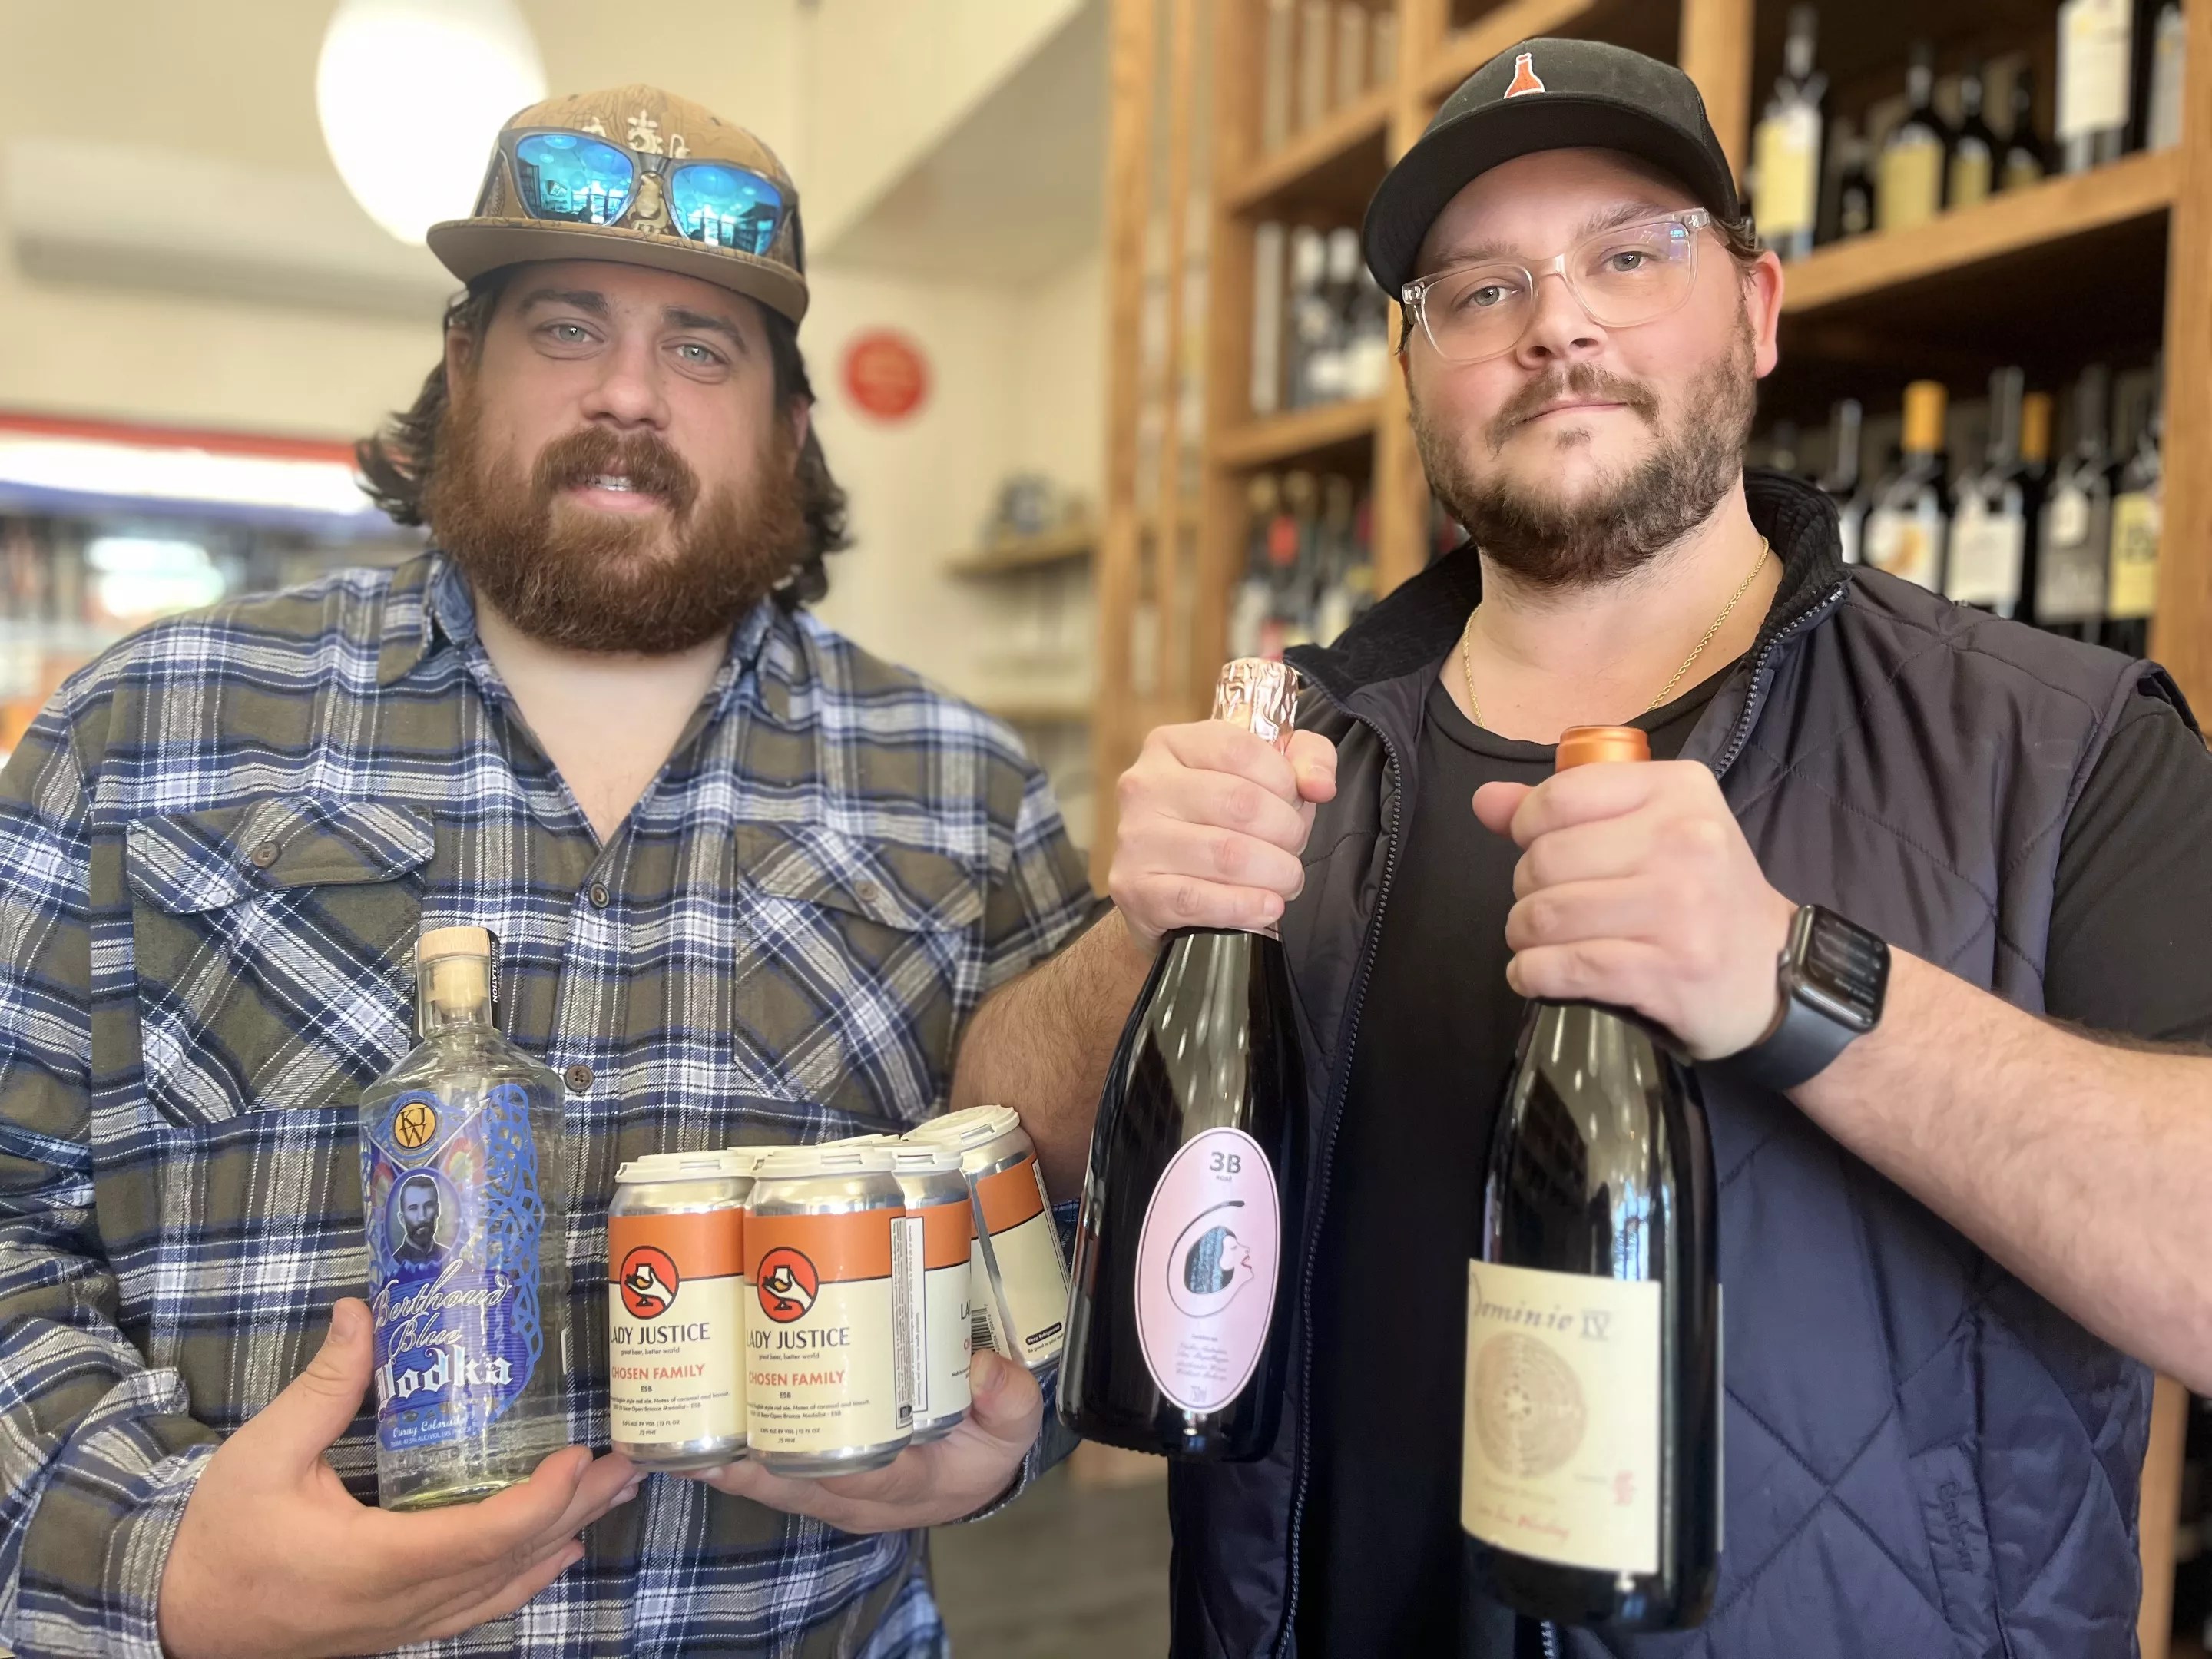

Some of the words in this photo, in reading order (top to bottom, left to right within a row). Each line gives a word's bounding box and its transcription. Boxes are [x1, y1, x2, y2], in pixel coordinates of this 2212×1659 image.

[1210, 1151, 1241, 1174] 3B
[373, 1258, 512, 1334] Berthoud
[388, 1311, 462, 1359] Blue
[610, 1326, 633, 1345] LADY
[637, 1322, 711, 1345] JUSTICE
[1582, 1307, 1612, 1341] IV
[747, 1329, 771, 1349] LADY
[776, 1327, 850, 1349] JUSTICE
[375, 1344, 514, 1422] Vodka
[611, 1366, 649, 1380] CHOSEN
[653, 1363, 705, 1380] FAMILY
[749, 1371, 788, 1386] CHOSEN
[792, 1369, 845, 1386] FAMILY
